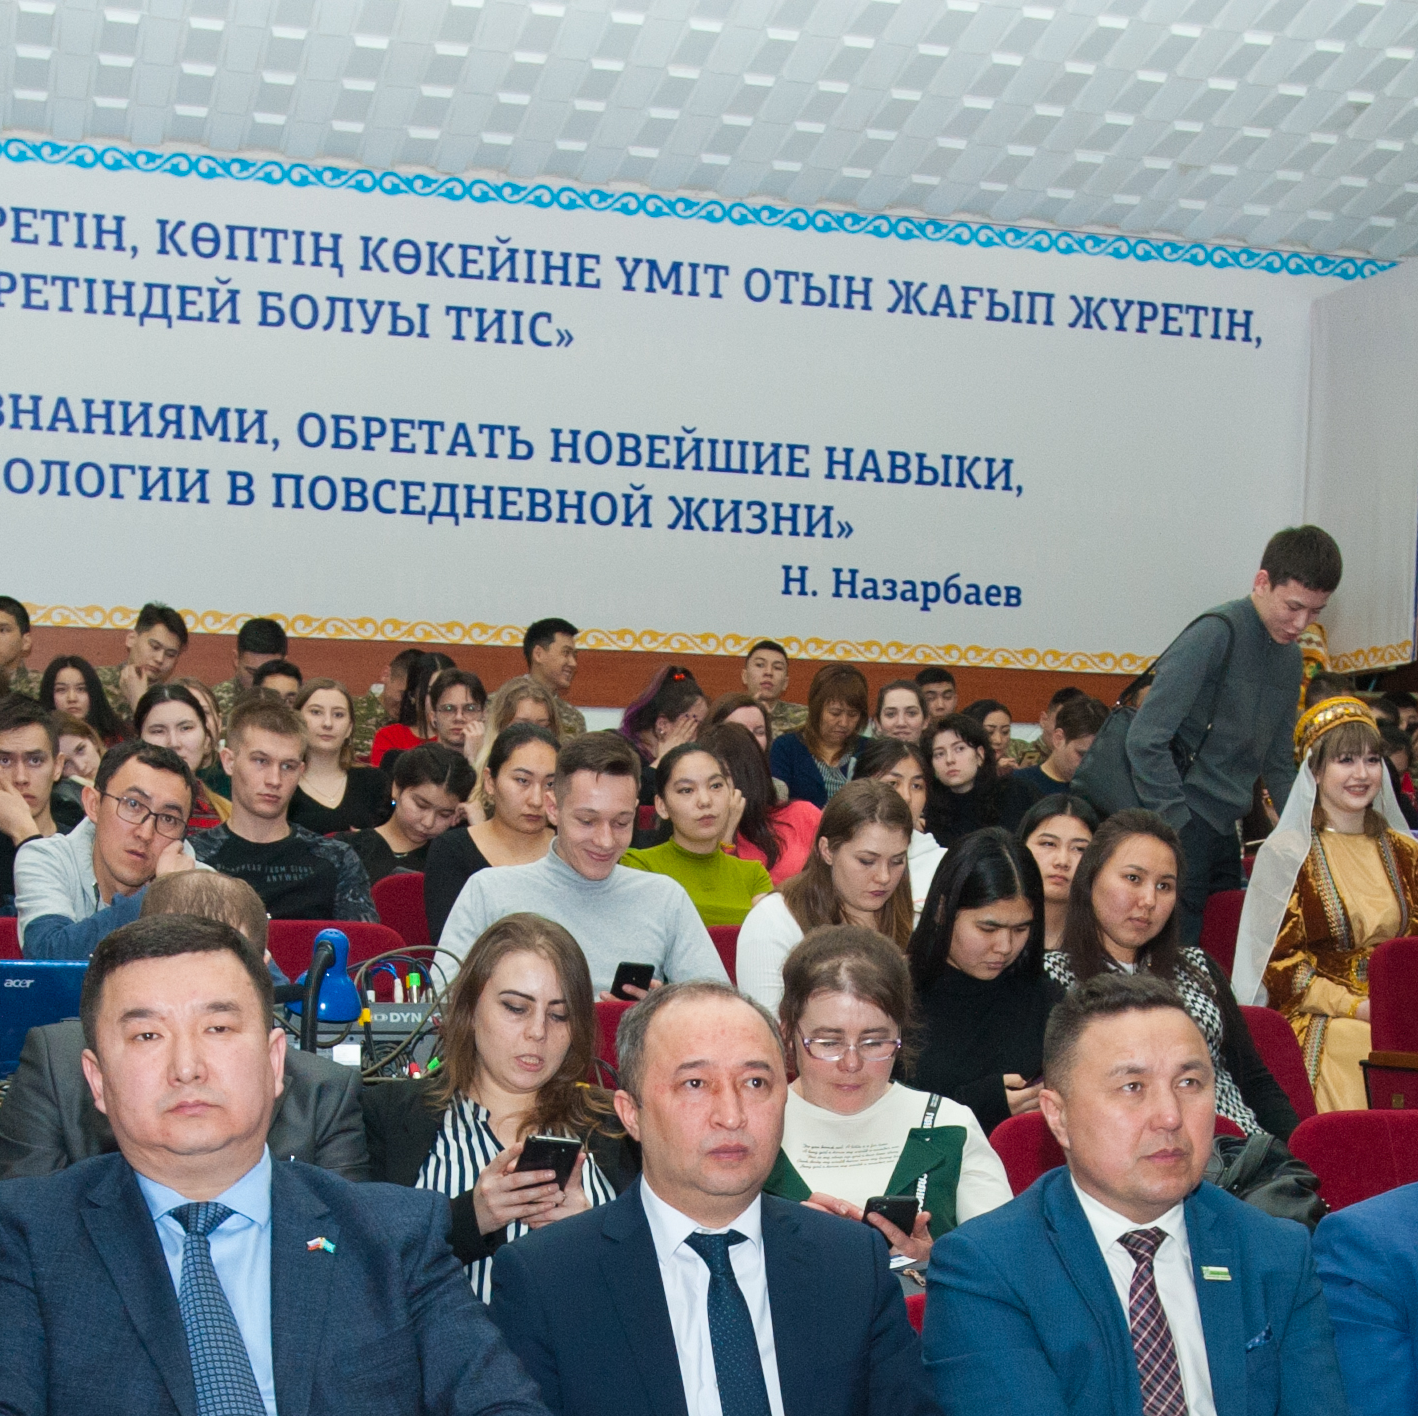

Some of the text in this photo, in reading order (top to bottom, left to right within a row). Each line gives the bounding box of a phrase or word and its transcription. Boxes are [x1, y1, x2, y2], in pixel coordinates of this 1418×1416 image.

[158, 220, 344, 278] КӨПТІҢ
[362, 237, 601, 289] КӨКЕЙІНЕ
[617, 258, 730, 299] ҮМІТ
[746, 269, 873, 311] ОТЫН
[889, 281, 1055, 327] ЖАҒЫП
[1070, 296, 1262, 348] ЖҮРЕТІН,
[260, 292, 430, 339] БОЛУЫ
[447, 307, 574, 347] ТИІС»
[299, 413, 535, 461] ОБРЕТАТЬ
[552, 428, 810, 478] НОВЕЙШИЕ
[826, 448, 1023, 497] НАВЫКИ,
[229, 472, 255, 506] В
[273, 474, 653, 529] ПОВСЕДНЕВНОЙ
[669, 497, 854, 539] ЖИЗНИ»
[782, 565, 1023, 612] Н. Назарбаев
[4, 979, 35, 988] acer
